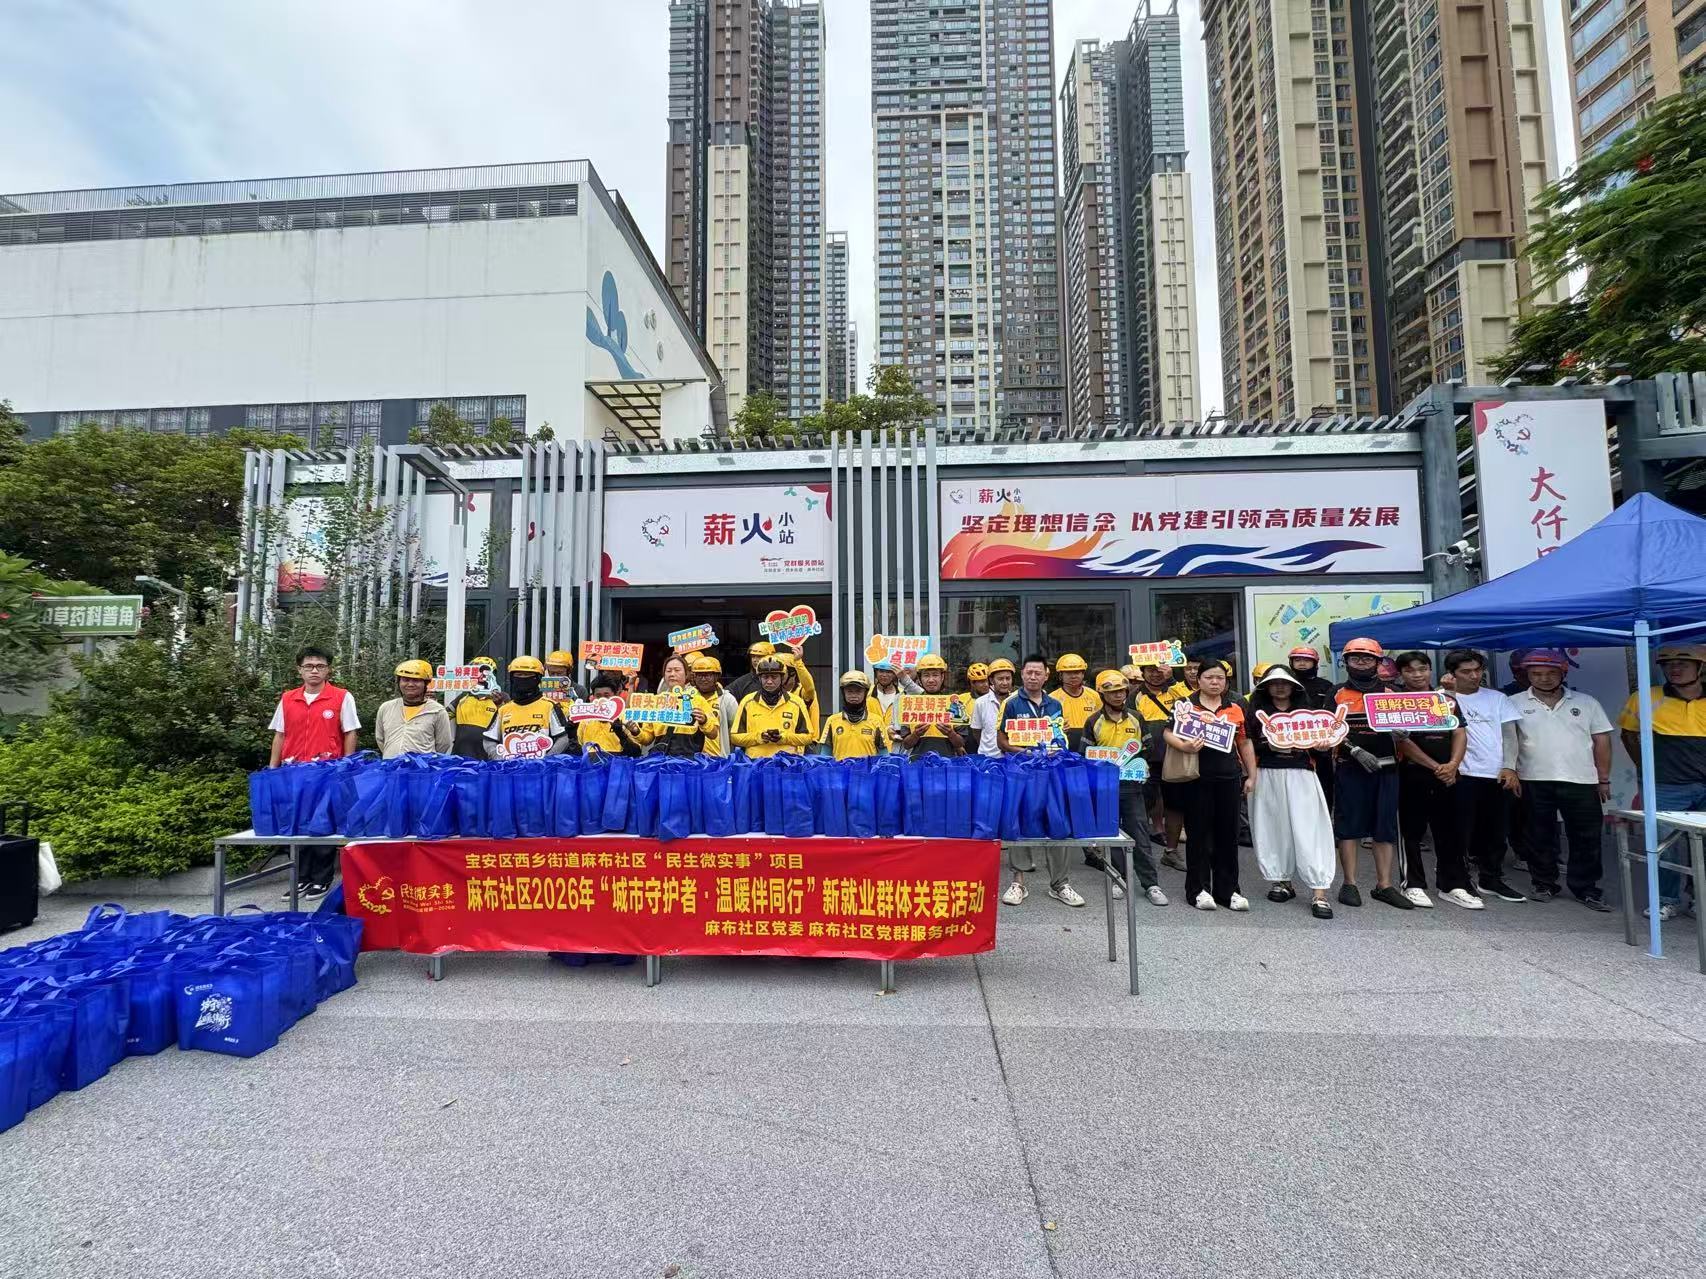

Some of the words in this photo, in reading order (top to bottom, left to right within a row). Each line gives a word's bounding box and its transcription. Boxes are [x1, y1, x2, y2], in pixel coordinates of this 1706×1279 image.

[979, 488, 1011, 504] 薪火
[961, 512, 1117, 534] 坚定理想信念
[1131, 506, 1400, 532] 以党建引领高质量发展
[1529, 466, 1568, 559] 大仟
[703, 512, 773, 545] 薪火
[778, 511, 794, 545] 小站
[890, 650, 918, 666] 点赞
[903, 697, 947, 711] 我是骑手
[1374, 698, 1431, 711] 理解包容
[1375, 712, 1429, 724] 温暖同行
[1119, 770, 1145, 779] 未来
[704, 920, 804, 937] 麻布社区党委
[808, 921, 976, 941] 麻布社区党群服务中心
